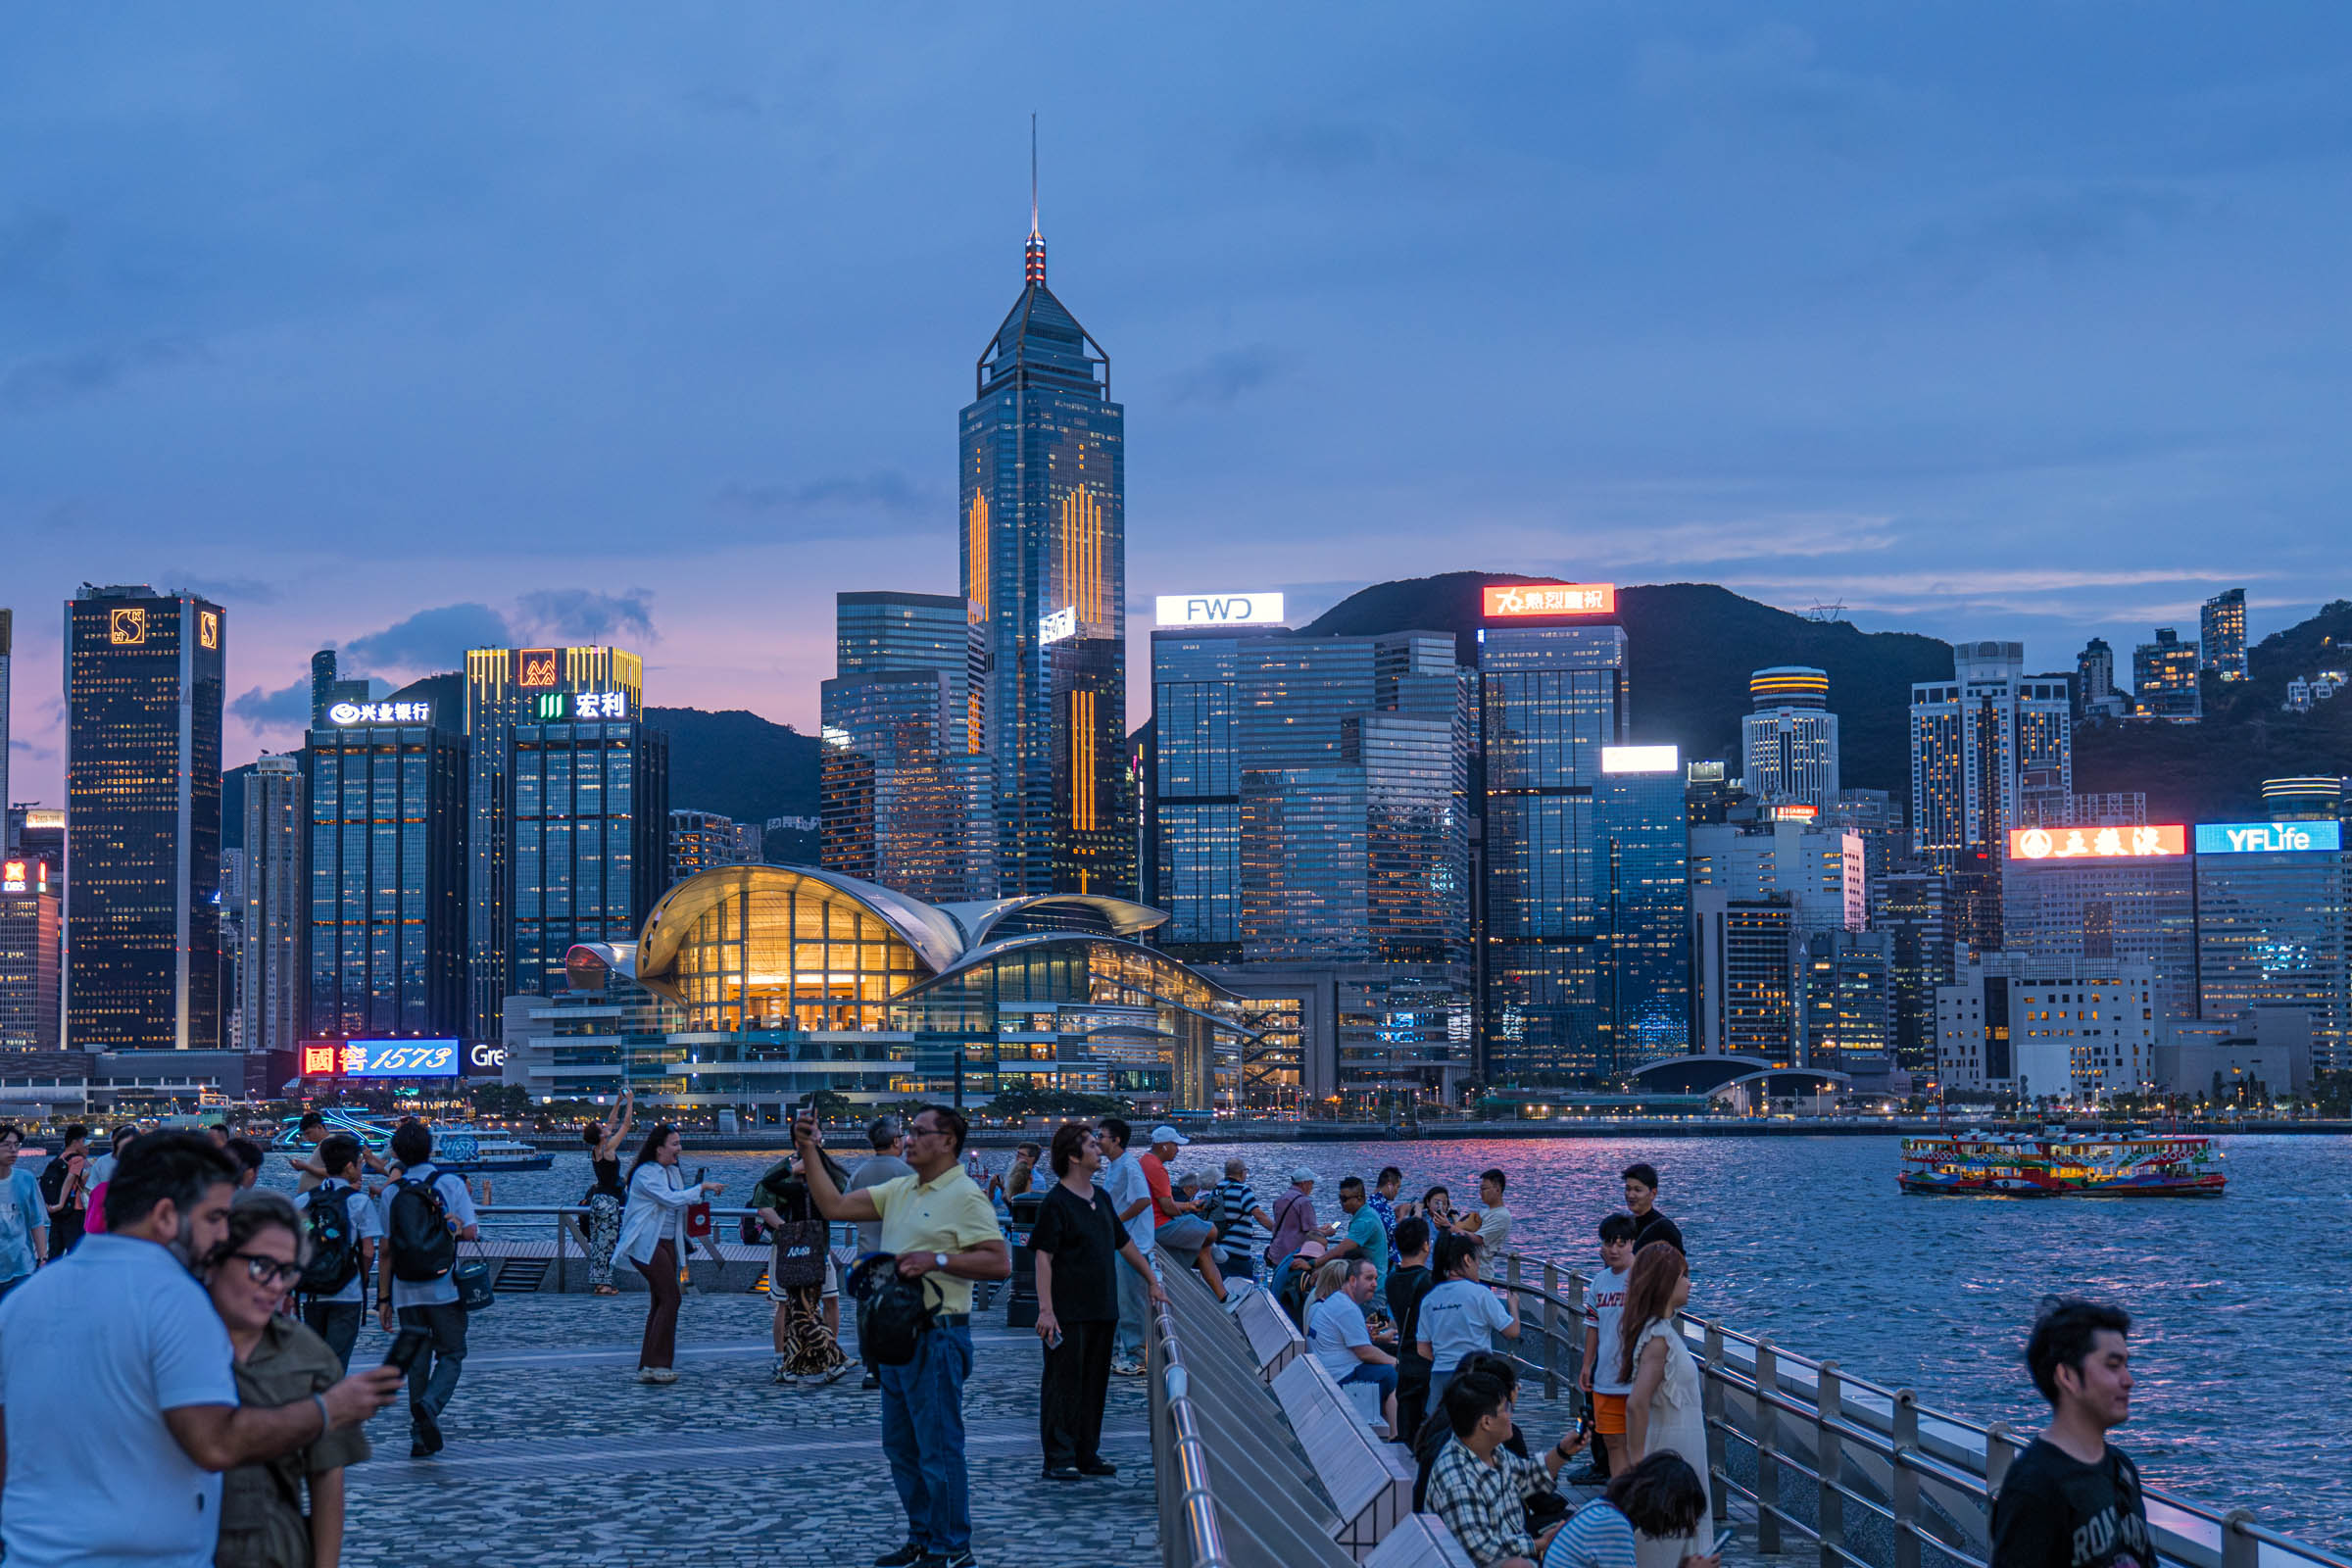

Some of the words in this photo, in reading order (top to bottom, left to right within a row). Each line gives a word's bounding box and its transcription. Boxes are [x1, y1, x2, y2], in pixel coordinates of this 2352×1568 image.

[1187, 597, 1252, 621] FWD
[1525, 590, 1604, 611] 熱烈慶祝
[359, 703, 430, 721] 兴业银行
[575, 692, 625, 717] 宏利
[2227, 823, 2311, 853] YFLife
[305, 1045, 368, 1074] 國窖
[368, 1047, 453, 1070] 1573
